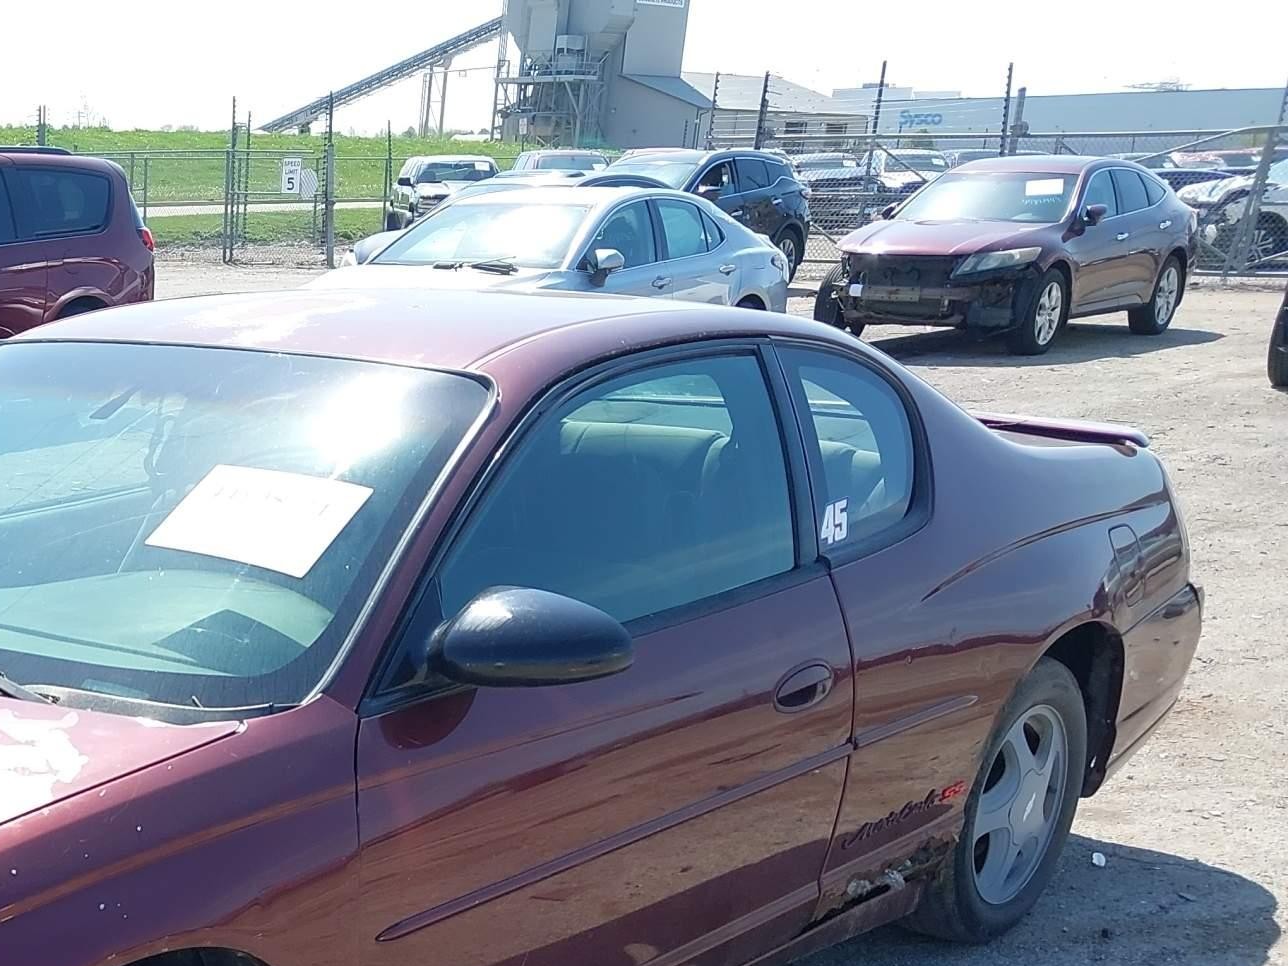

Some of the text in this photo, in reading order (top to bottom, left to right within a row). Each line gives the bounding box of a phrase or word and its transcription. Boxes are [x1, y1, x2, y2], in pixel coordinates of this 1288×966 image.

[899, 110, 943, 128] Sysco
[287, 177, 295, 190] 5
[821, 497, 848, 545] 45
